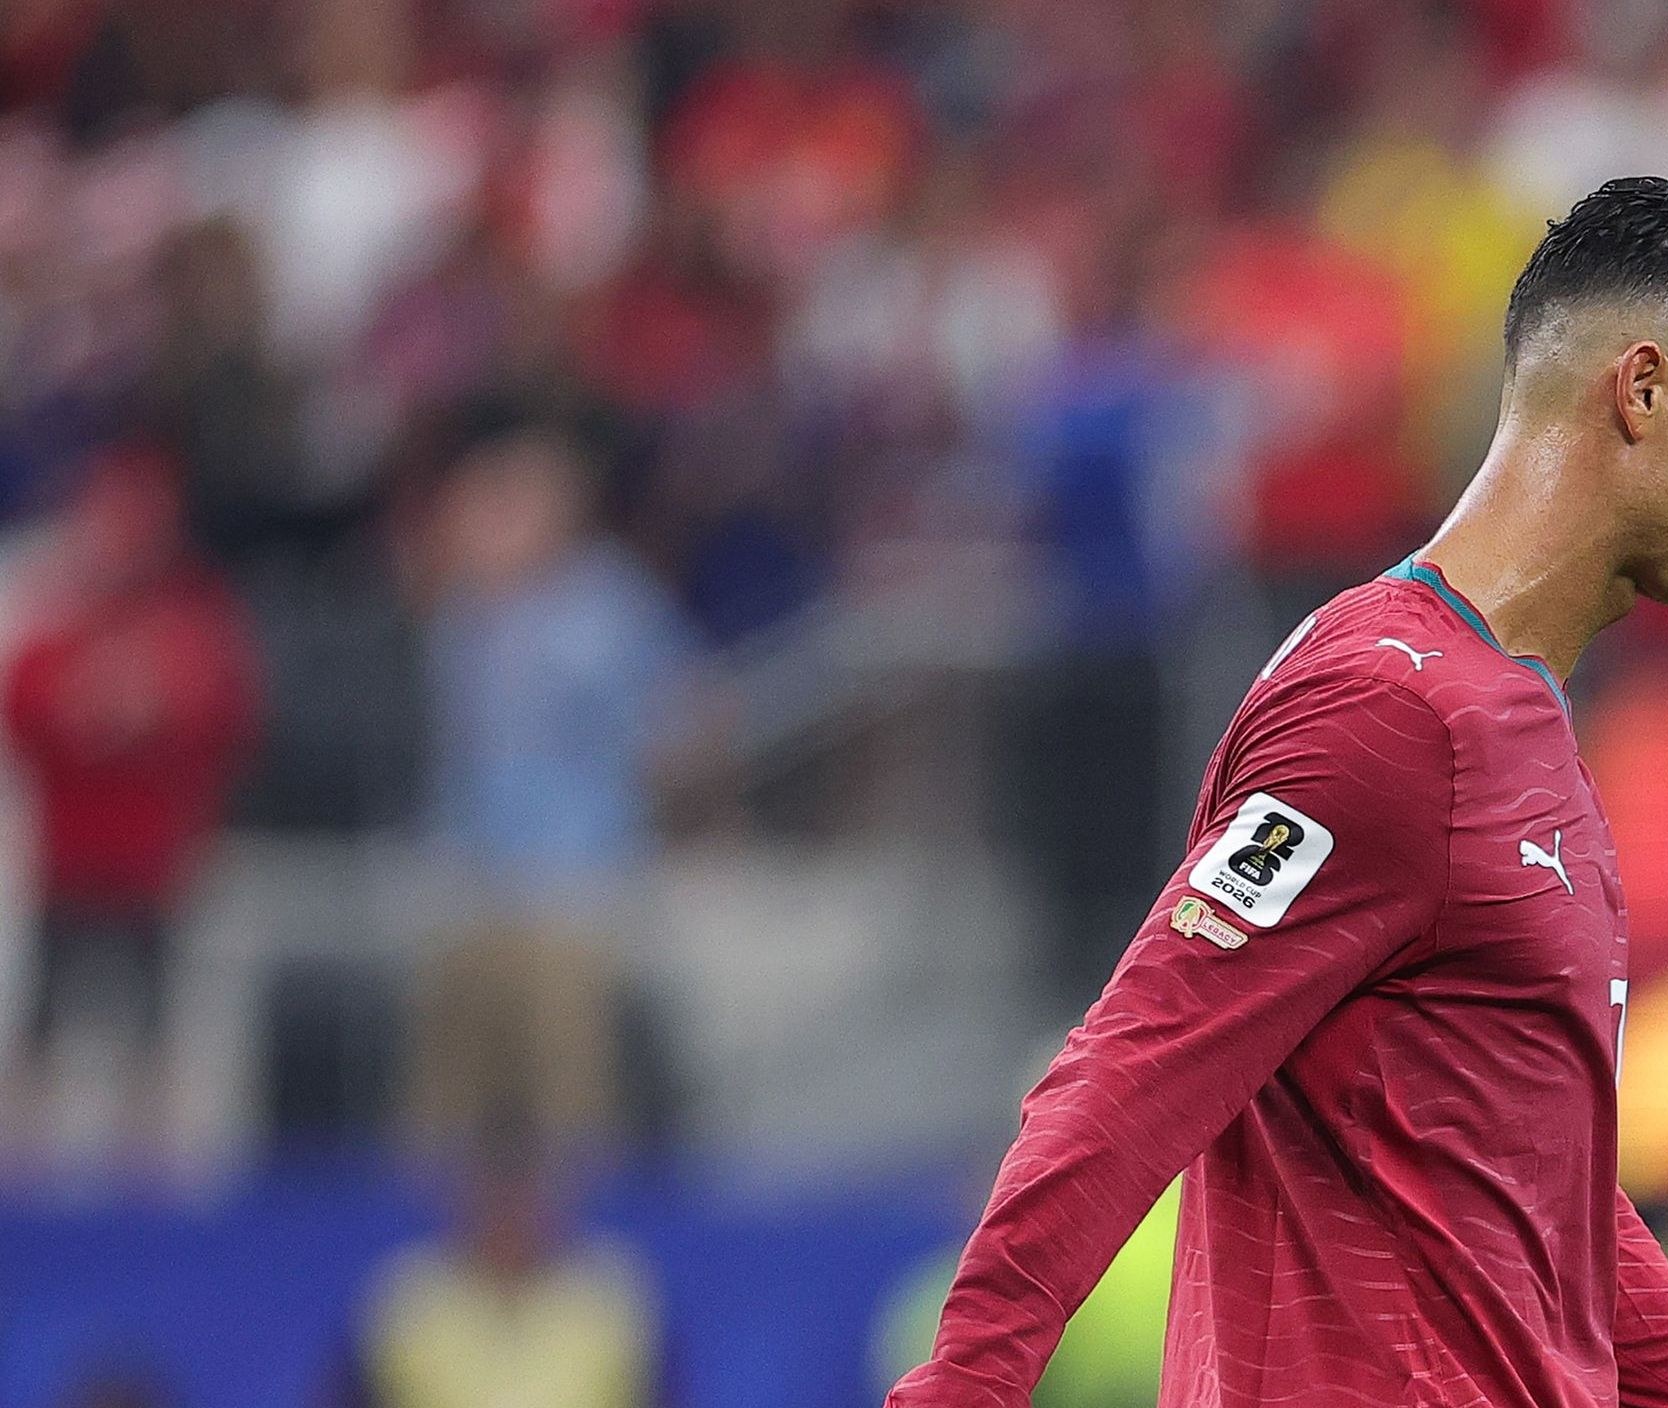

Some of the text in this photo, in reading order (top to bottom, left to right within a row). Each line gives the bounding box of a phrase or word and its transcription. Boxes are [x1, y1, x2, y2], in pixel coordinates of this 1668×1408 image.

[1239, 861, 1261, 880] FIFA
[1211, 877, 1256, 909] 2026
[1219, 870, 1262, 898] WORLD CUP
[1203, 922, 1236, 943] LEGACY
